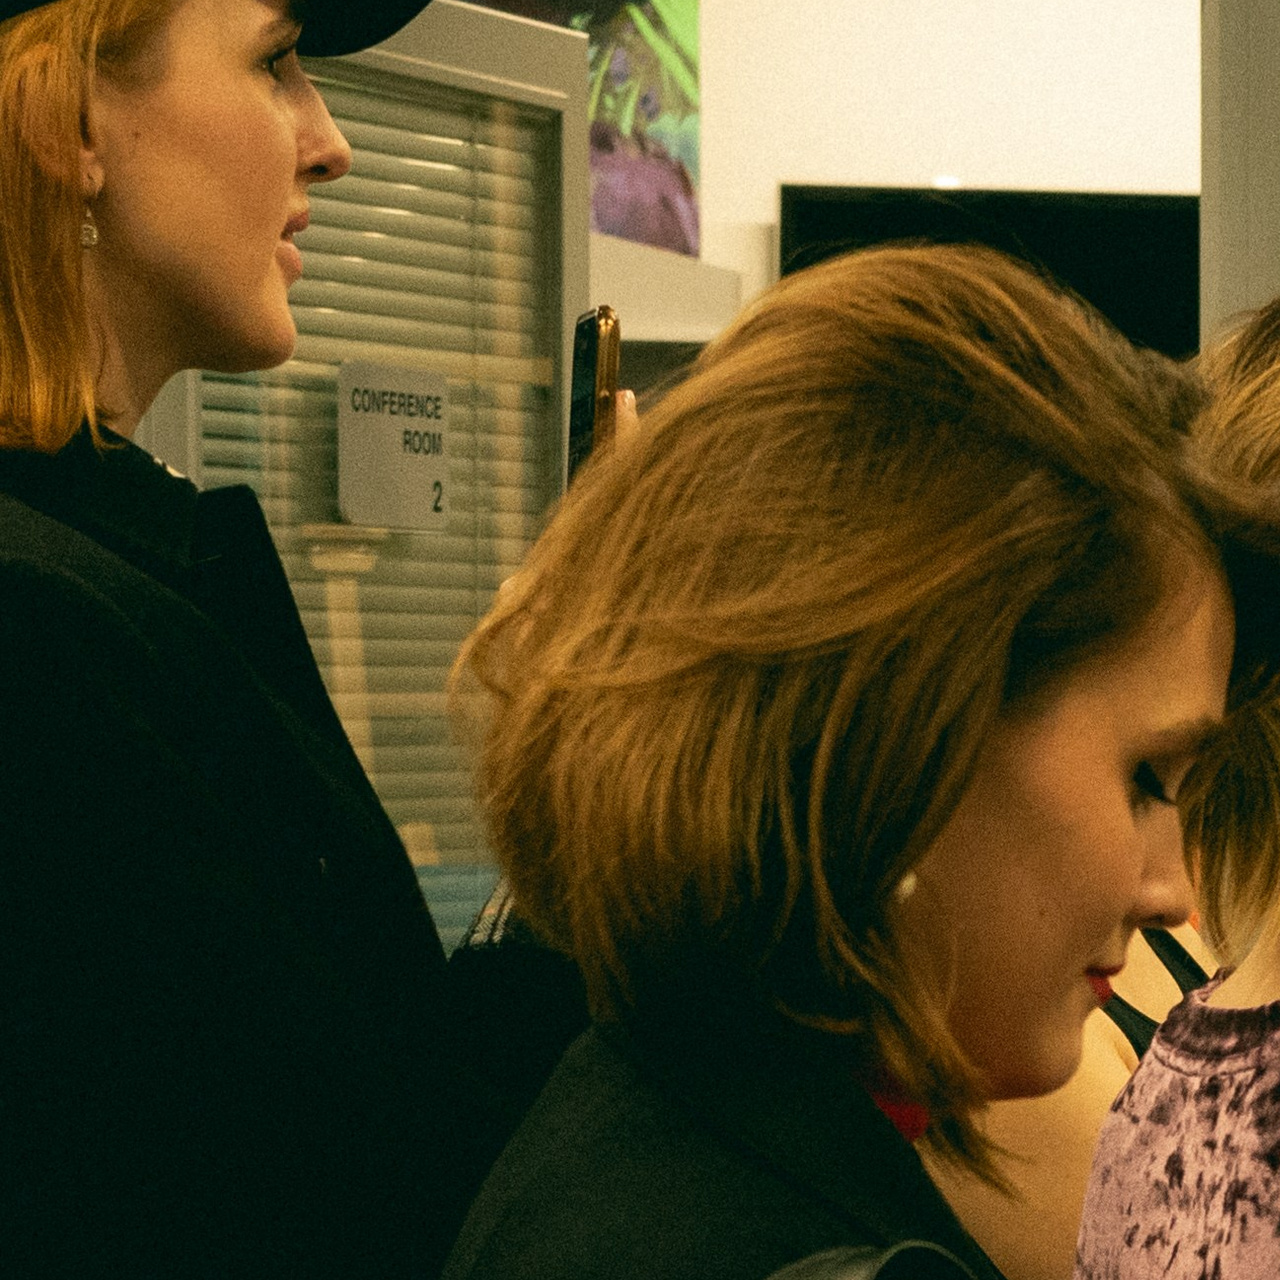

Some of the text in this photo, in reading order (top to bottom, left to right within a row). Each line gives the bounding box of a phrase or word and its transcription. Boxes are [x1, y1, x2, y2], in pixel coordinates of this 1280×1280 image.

[352, 387, 442, 420] CONFERENCE
[403, 429, 443, 456] ROOM
[432, 480, 443, 513] 2
